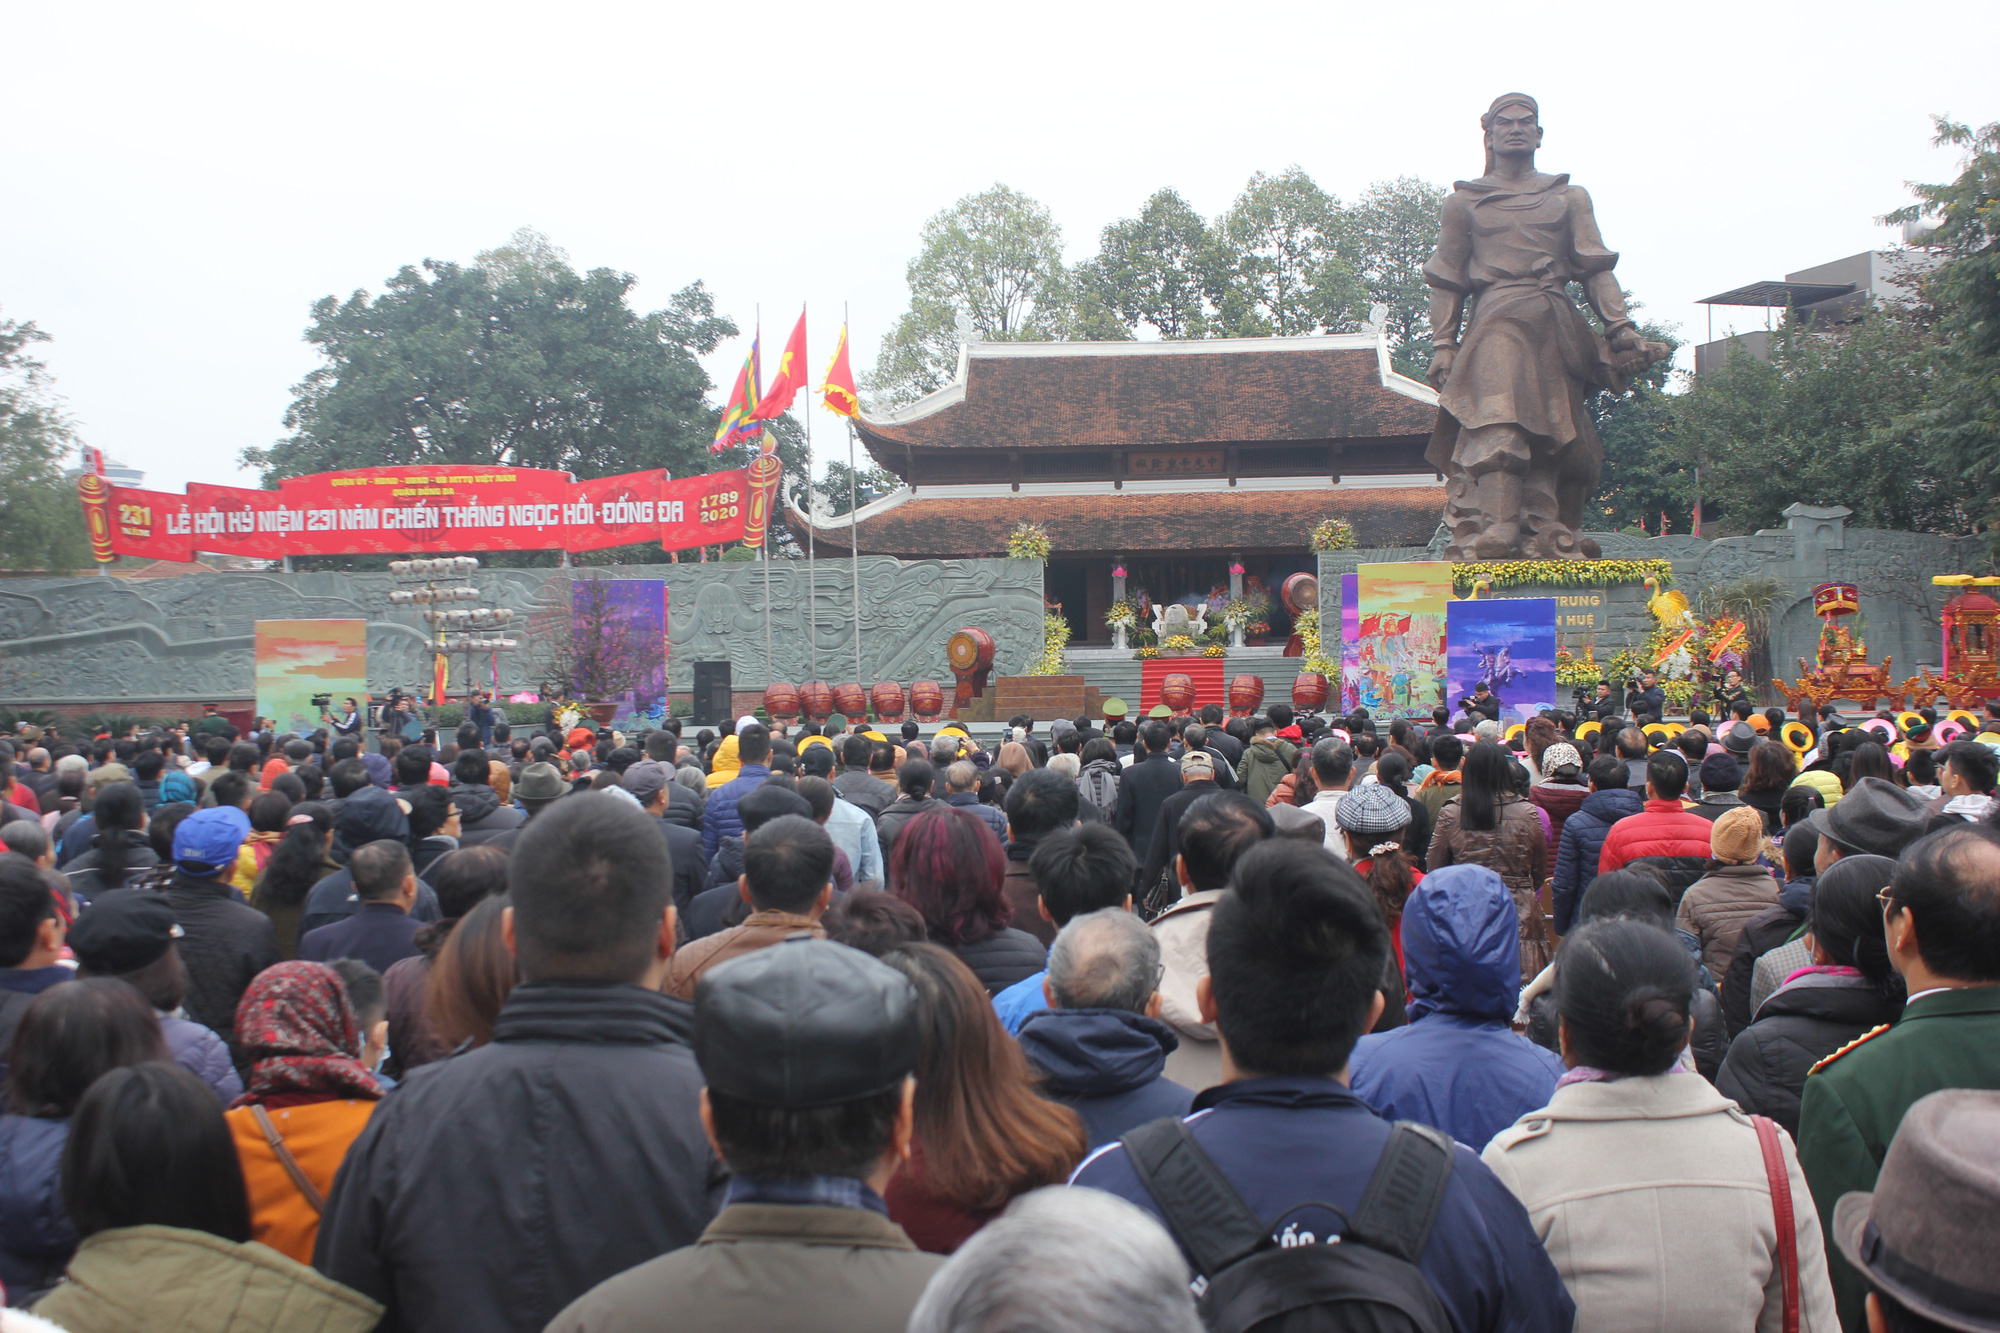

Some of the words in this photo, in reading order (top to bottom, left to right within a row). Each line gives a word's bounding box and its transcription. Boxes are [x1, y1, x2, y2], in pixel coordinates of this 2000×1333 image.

[495, 474, 517, 482] NAM
[392, 487, 416, 497] QUẬN
[700, 490, 739, 508] 1789
[118, 504, 151, 526] 231
[194, 505, 226, 539] HỘI
[228, 504, 255, 533] KỶ
[257, 504, 304, 537] NIỆM
[306, 509, 338, 531] 231
[340, 503, 379, 530] NĂM
[382, 498, 440, 529] CHIẾN
[442, 495, 505, 528] THẮNG
[508, 504, 559, 532] NGỌC
[657, 500, 684, 523] ĐA
[700, 505, 739, 522] 2020
[1566, 613, 1595, 628] HUỆ
